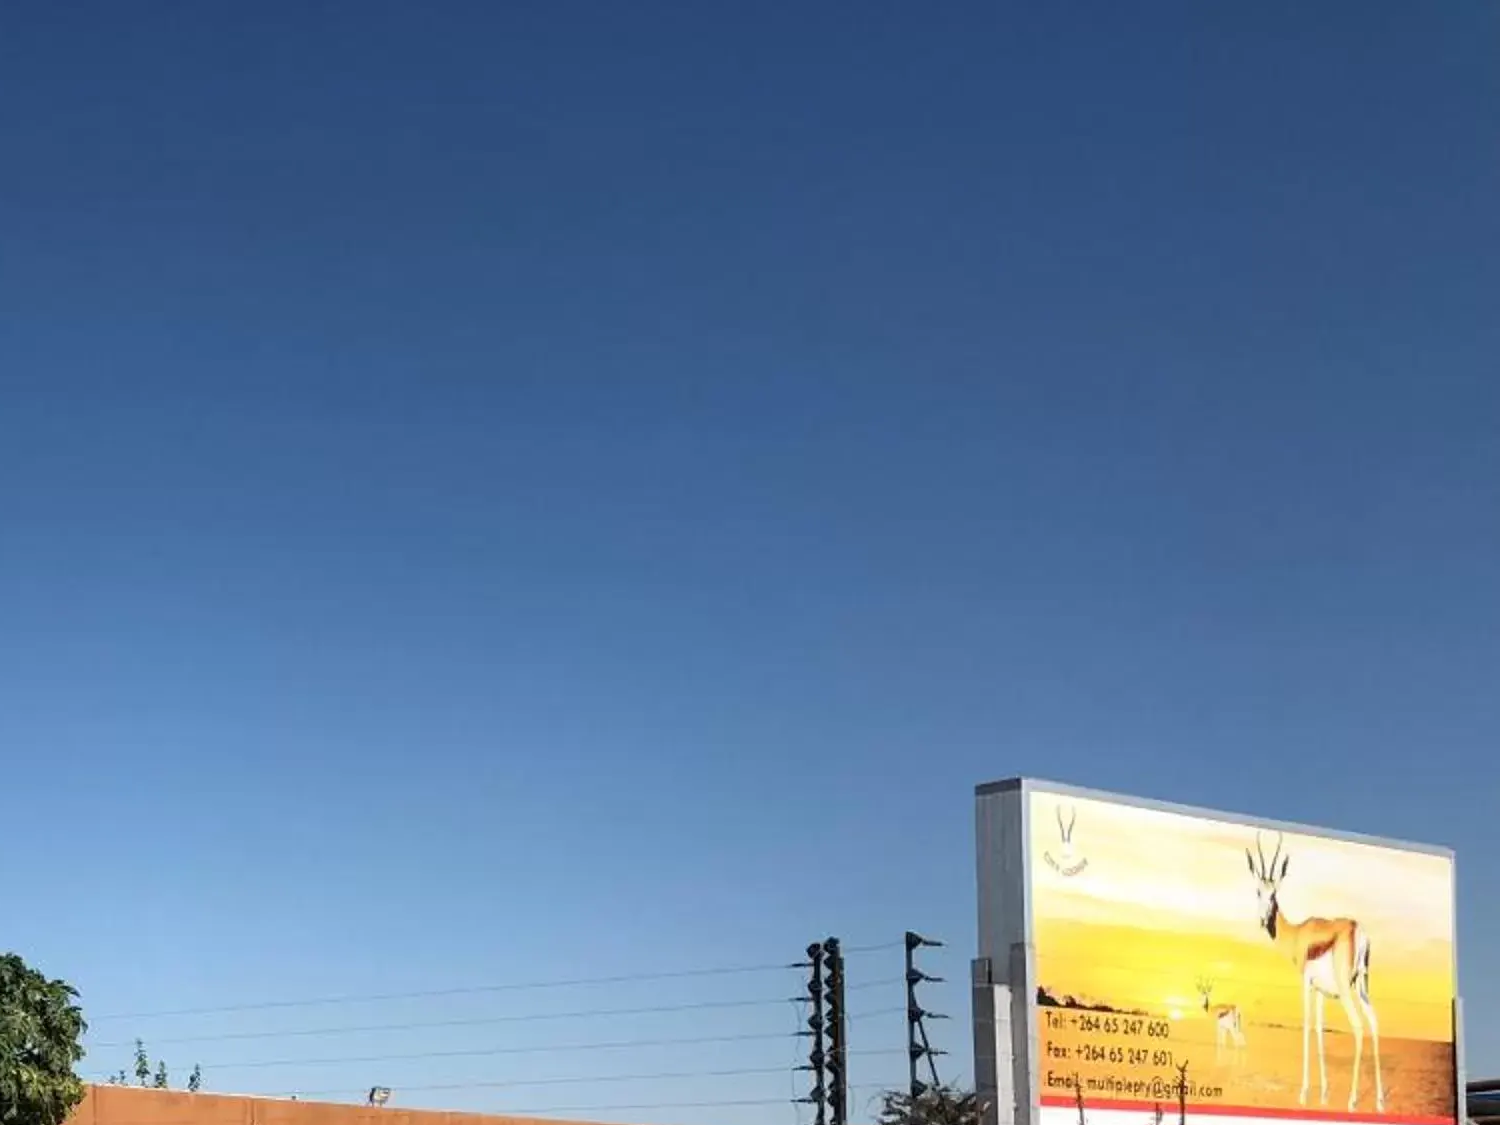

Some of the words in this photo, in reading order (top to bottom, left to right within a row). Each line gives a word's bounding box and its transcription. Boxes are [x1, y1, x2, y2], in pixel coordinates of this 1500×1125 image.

[1045, 1011, 1067, 1030] Tel:
[1070, 1015, 1101, 1032] +264
[1103, 1018, 1120, 1034] 65
[1123, 1019, 1144, 1036] 247
[1147, 1021, 1170, 1038] 600
[1046, 1041, 1071, 1059] Fax:
[1075, 1044, 1106, 1062] +264
[1109, 1047, 1124, 1064] 65
[1128, 1048, 1149, 1066] 247
[1152, 1050, 1174, 1067] 601
